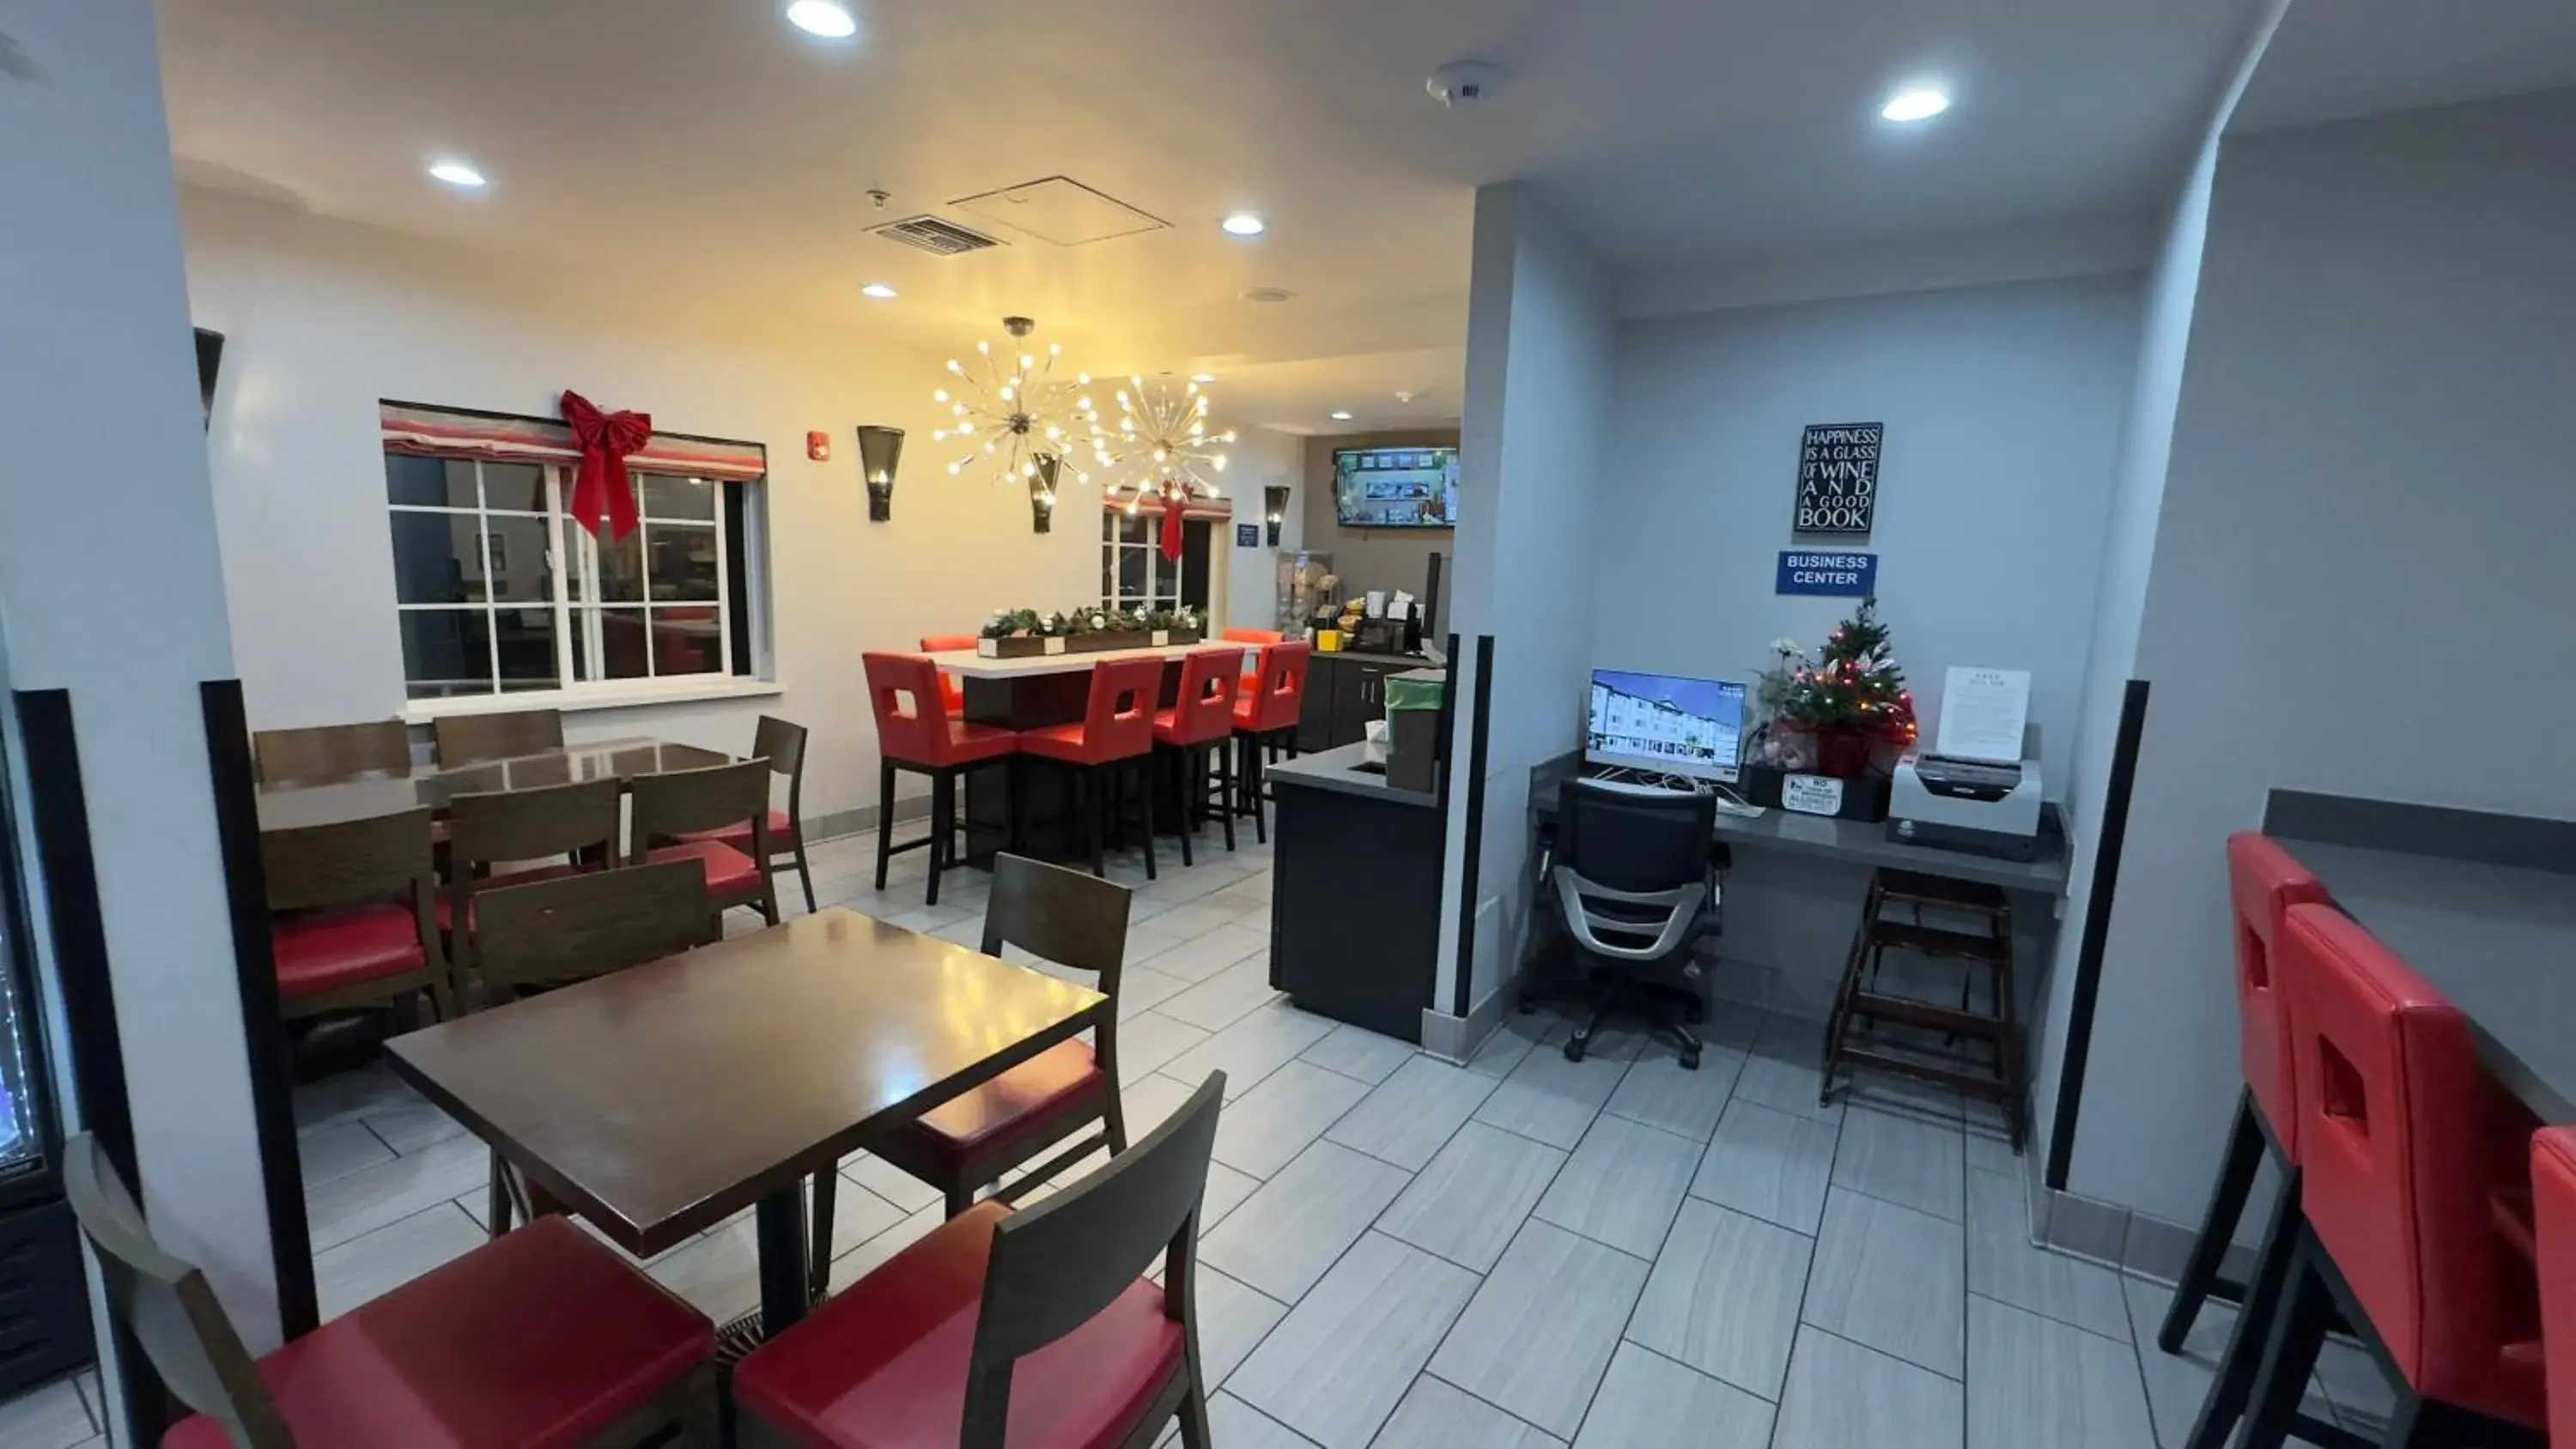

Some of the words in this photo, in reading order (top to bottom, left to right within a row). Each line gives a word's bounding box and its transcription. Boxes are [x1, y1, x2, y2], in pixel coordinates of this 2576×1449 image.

[1807, 430, 1878, 445] HAPPINESS
[1806, 447, 1818, 460] IS
[1820, 447, 1830, 460] A
[1833, 446, 1876, 460] GLASS
[1804, 462, 1819, 479] OF
[1820, 461, 1873, 479] WINE
[1803, 478, 1871, 495] AND
[1803, 497, 1811, 507] A
[1819, 495, 1869, 507] GOOD
[1800, 508, 1866, 527] BOOK
[1787, 555, 1868, 569] BUSINESS
[1793, 571, 1857, 585] CENTER
